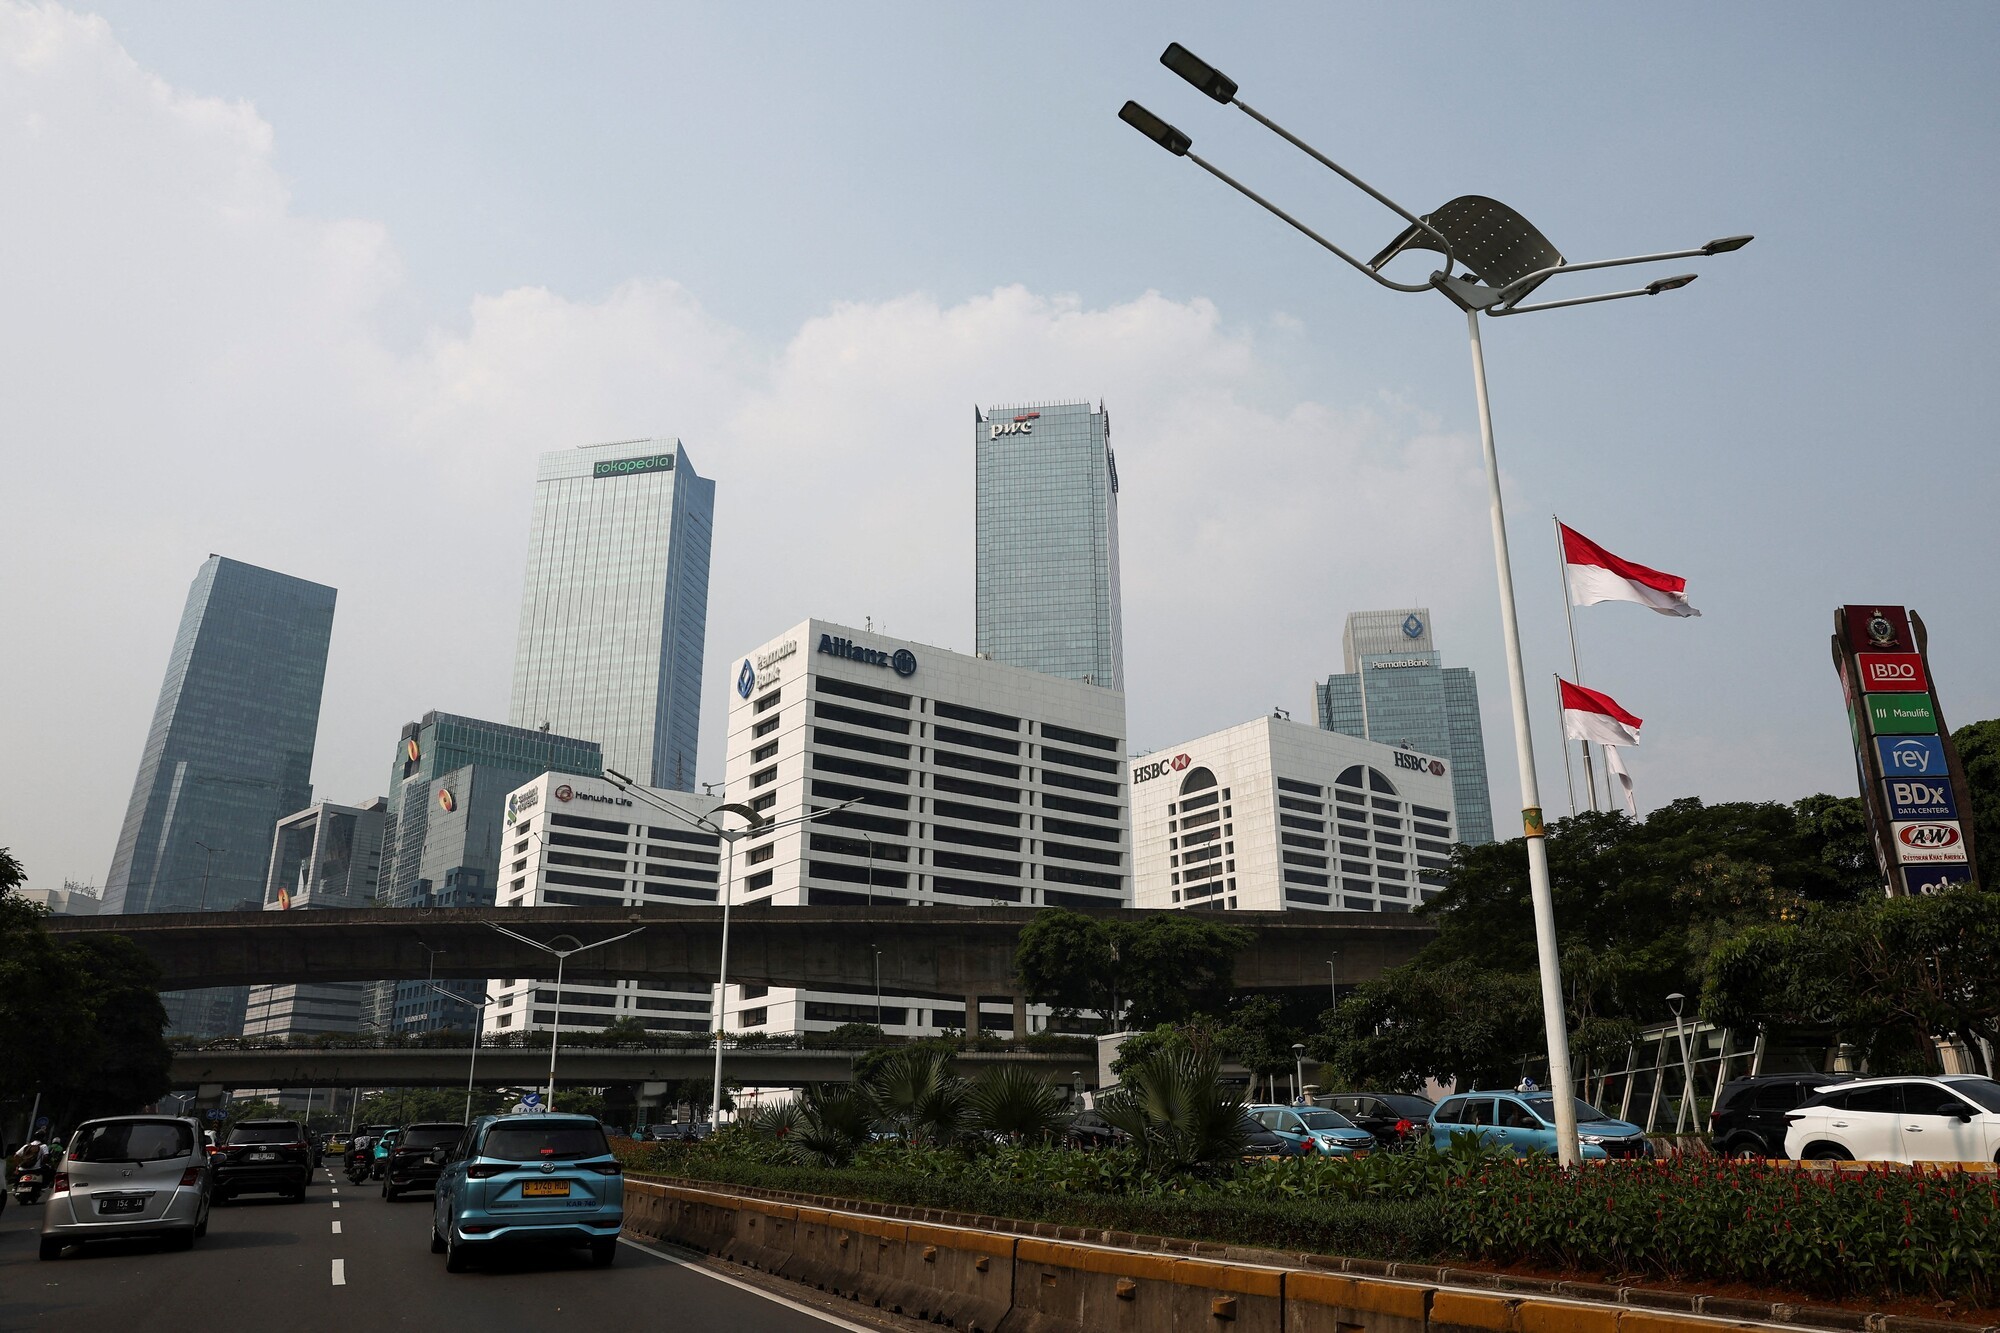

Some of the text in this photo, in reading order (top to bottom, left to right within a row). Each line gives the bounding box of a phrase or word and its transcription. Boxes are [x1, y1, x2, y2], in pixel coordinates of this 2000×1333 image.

[990, 421, 1032, 440] pwc
[596, 456, 669, 473] tokopedia
[817, 633, 888, 669] Allianz
[1372, 658, 1430, 670] Permata Bank
[1893, 708, 1930, 718] Manulife
[1393, 750, 1428, 773] HSBC
[1892, 749, 1930, 773] rey
[1132, 758, 1170, 785] HSBC
[575, 791, 633, 807] Hanwha Life
[1892, 783, 1946, 805] BDx
[1897, 807, 1917, 815] DATA
[1911, 828, 1949, 845] A&W
[566, 1200, 582, 1208] KAR
